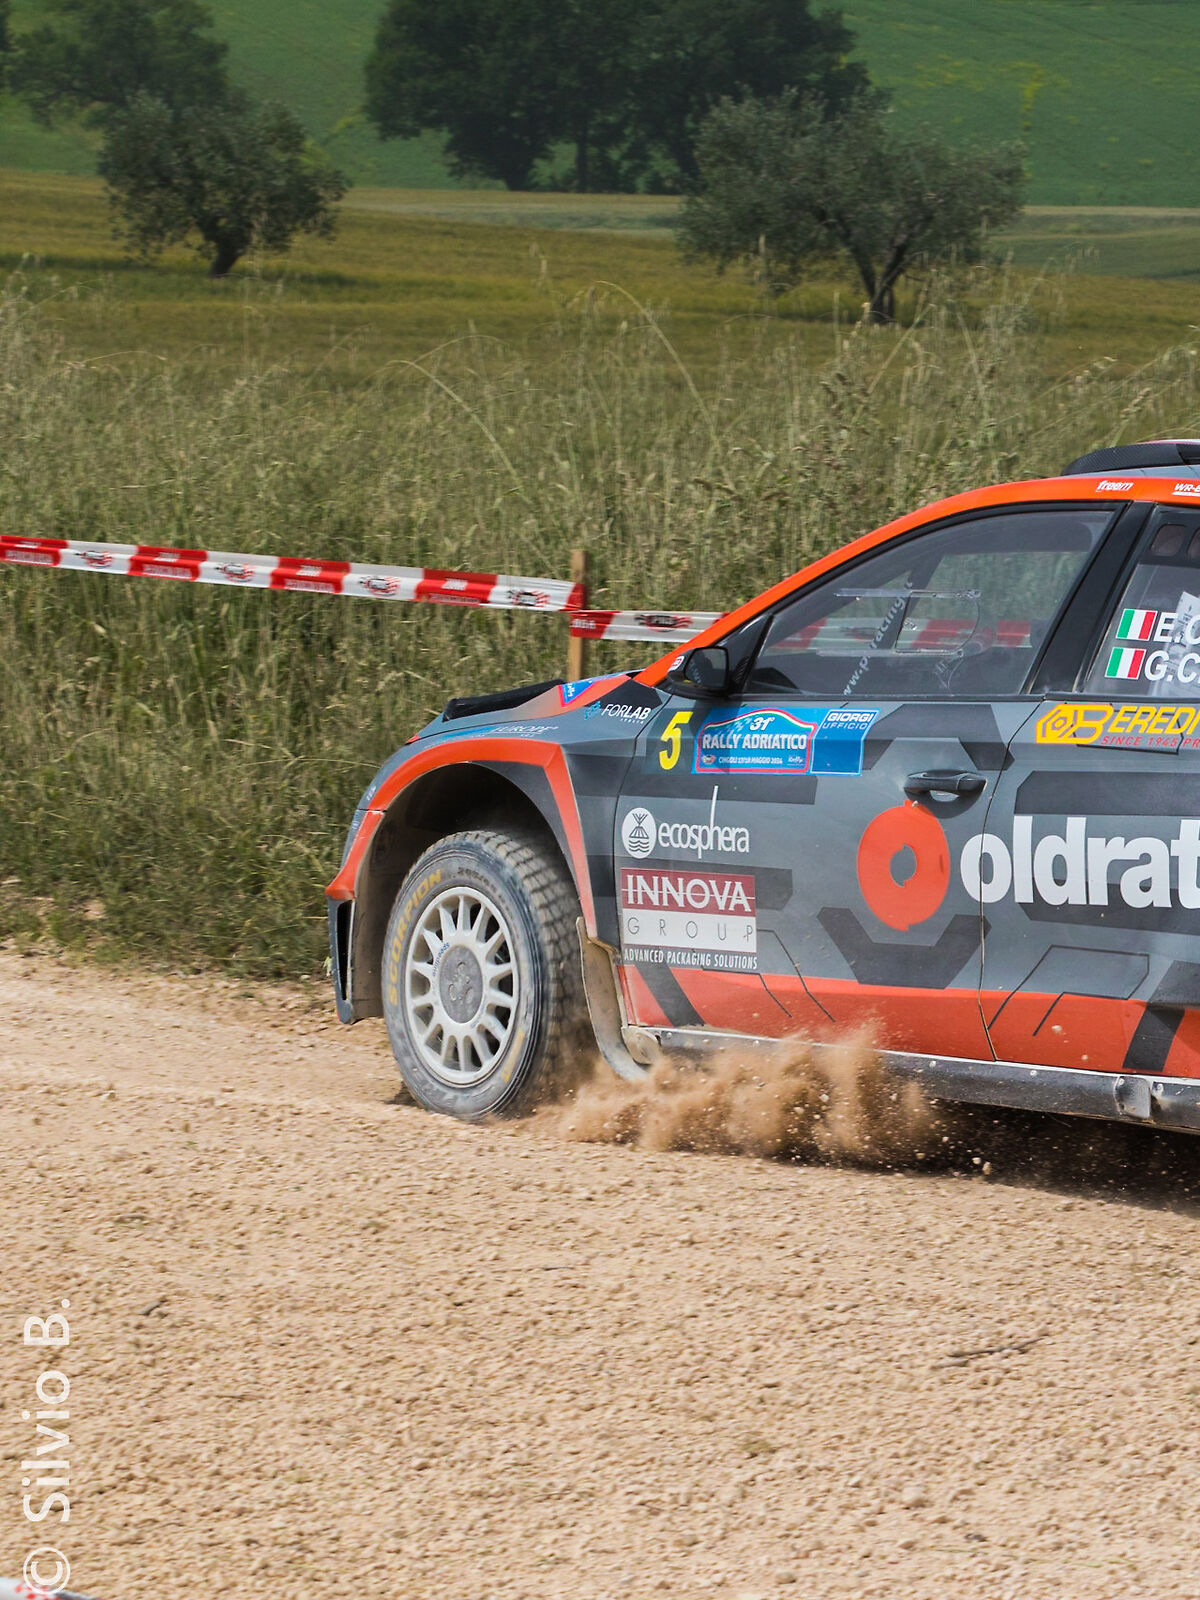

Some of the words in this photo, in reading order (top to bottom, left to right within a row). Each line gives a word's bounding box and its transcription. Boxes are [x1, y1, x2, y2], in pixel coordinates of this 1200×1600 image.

[601, 704, 651, 720] FORLAB
[826, 712, 874, 723] GIORGI
[822, 722, 868, 731] UFFICIO
[658, 711, 693, 770] 5
[703, 733, 742, 749] RALLY
[742, 733, 807, 750] ADRIATICO
[1101, 735, 1141, 746] SINCE
[658, 785, 749, 859] ecosphera
[626, 874, 751, 912] INNOVA
[388, 869, 441, 1006] SCORPION
[627, 917, 753, 943] GROUP
[624, 948, 664, 963] ADVANCED
[666, 951, 711, 967] PACKAGING
[714, 954, 758, 970] SOLUTIONS
